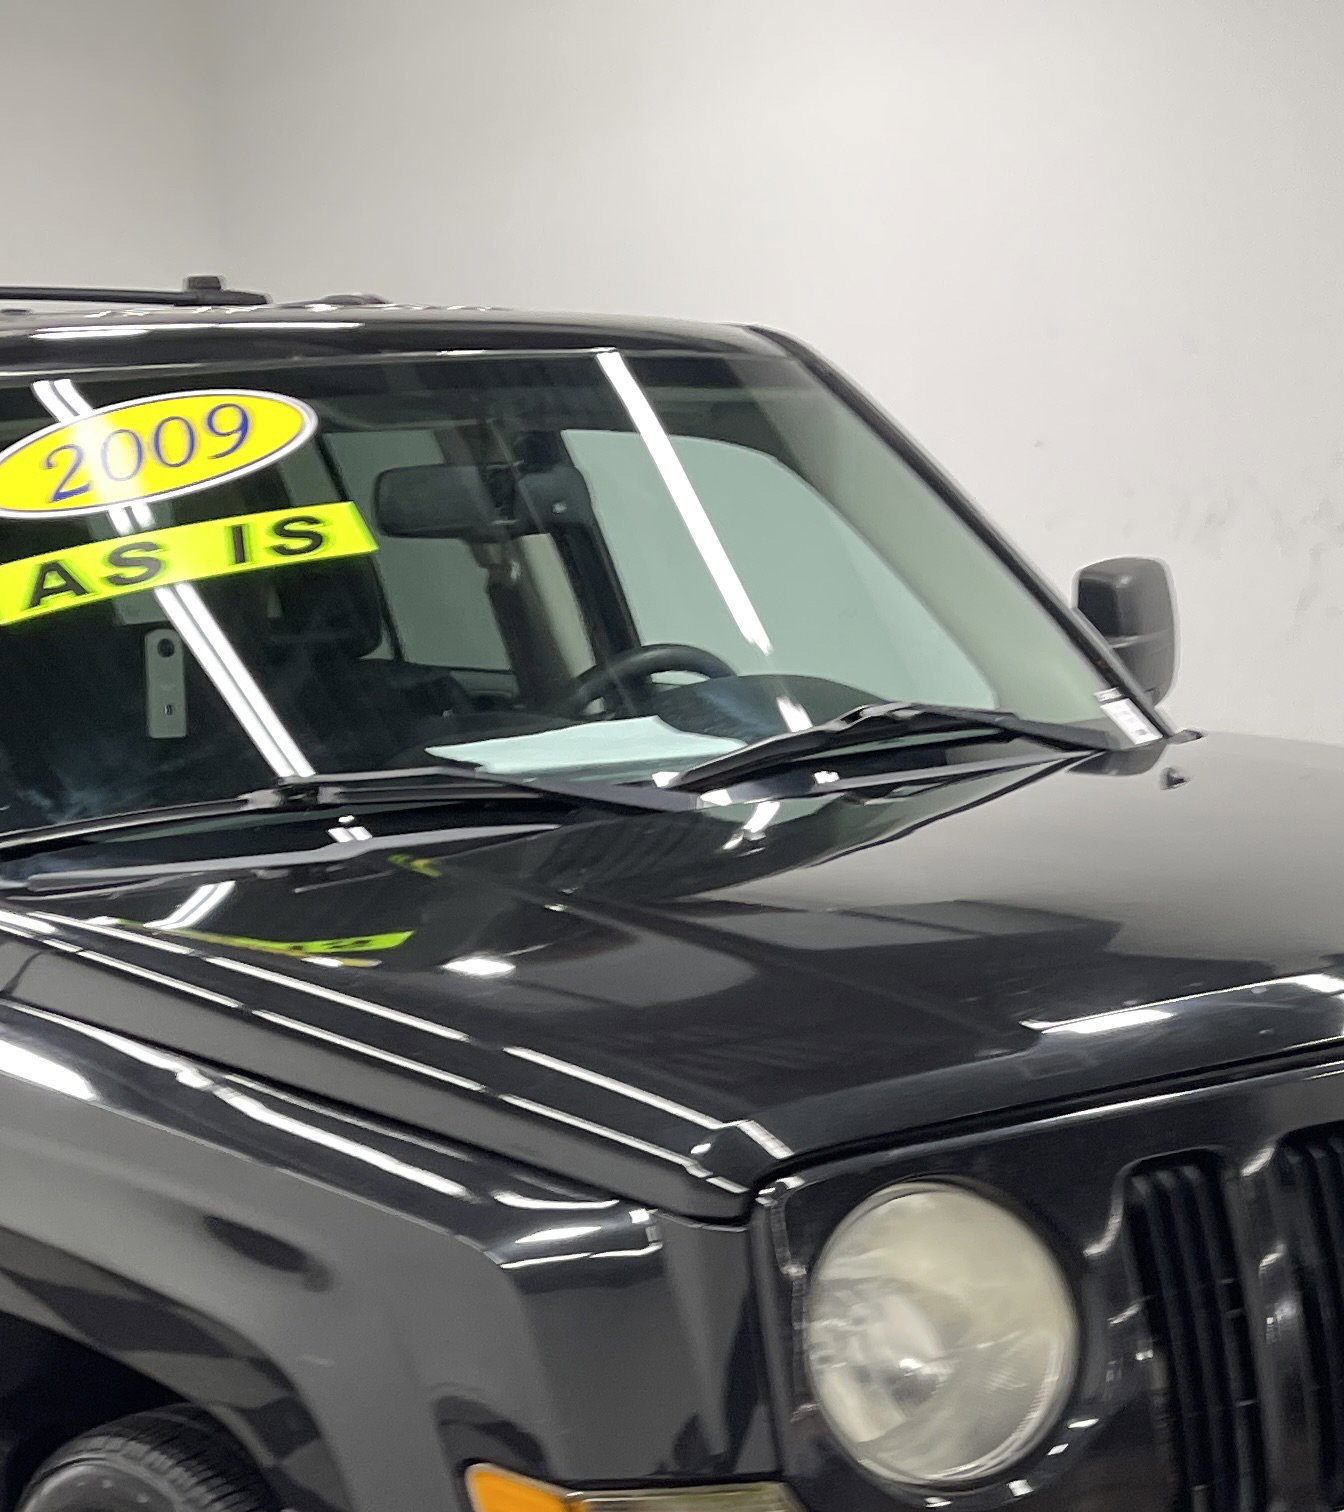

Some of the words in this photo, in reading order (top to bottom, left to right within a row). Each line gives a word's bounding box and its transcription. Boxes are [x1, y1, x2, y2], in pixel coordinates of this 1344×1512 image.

[43, 403, 250, 502] 2009
[25, 541, 164, 609] AS
[229, 515, 324, 565] IS
